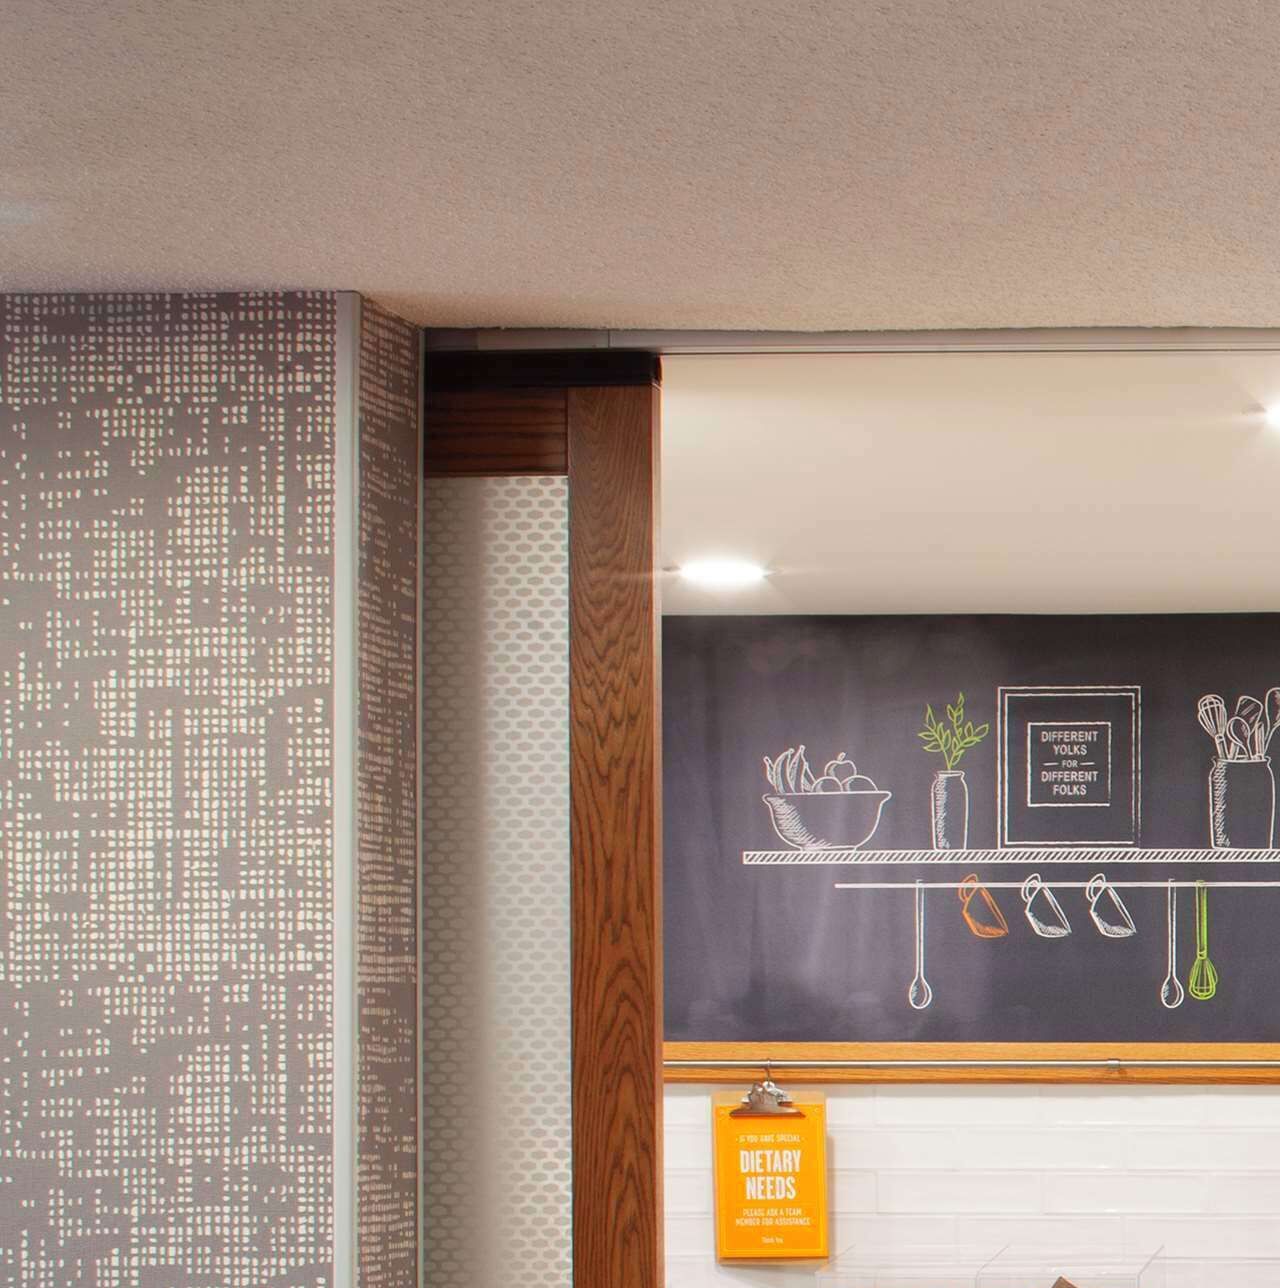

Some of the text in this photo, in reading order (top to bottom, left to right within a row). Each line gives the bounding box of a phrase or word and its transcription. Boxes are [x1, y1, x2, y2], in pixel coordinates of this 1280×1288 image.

[1041, 731, 1098, 742] DIFFERENT
[1053, 744, 1087, 755] YOLKS
[1062, 760, 1078, 768] FOR
[1041, 771, 1098, 782] DIFFERENT
[1053, 784, 1087, 795] FOLKS
[740, 1150, 801, 1173] DIETARY
[746, 1176, 796, 1200] NEEDS
